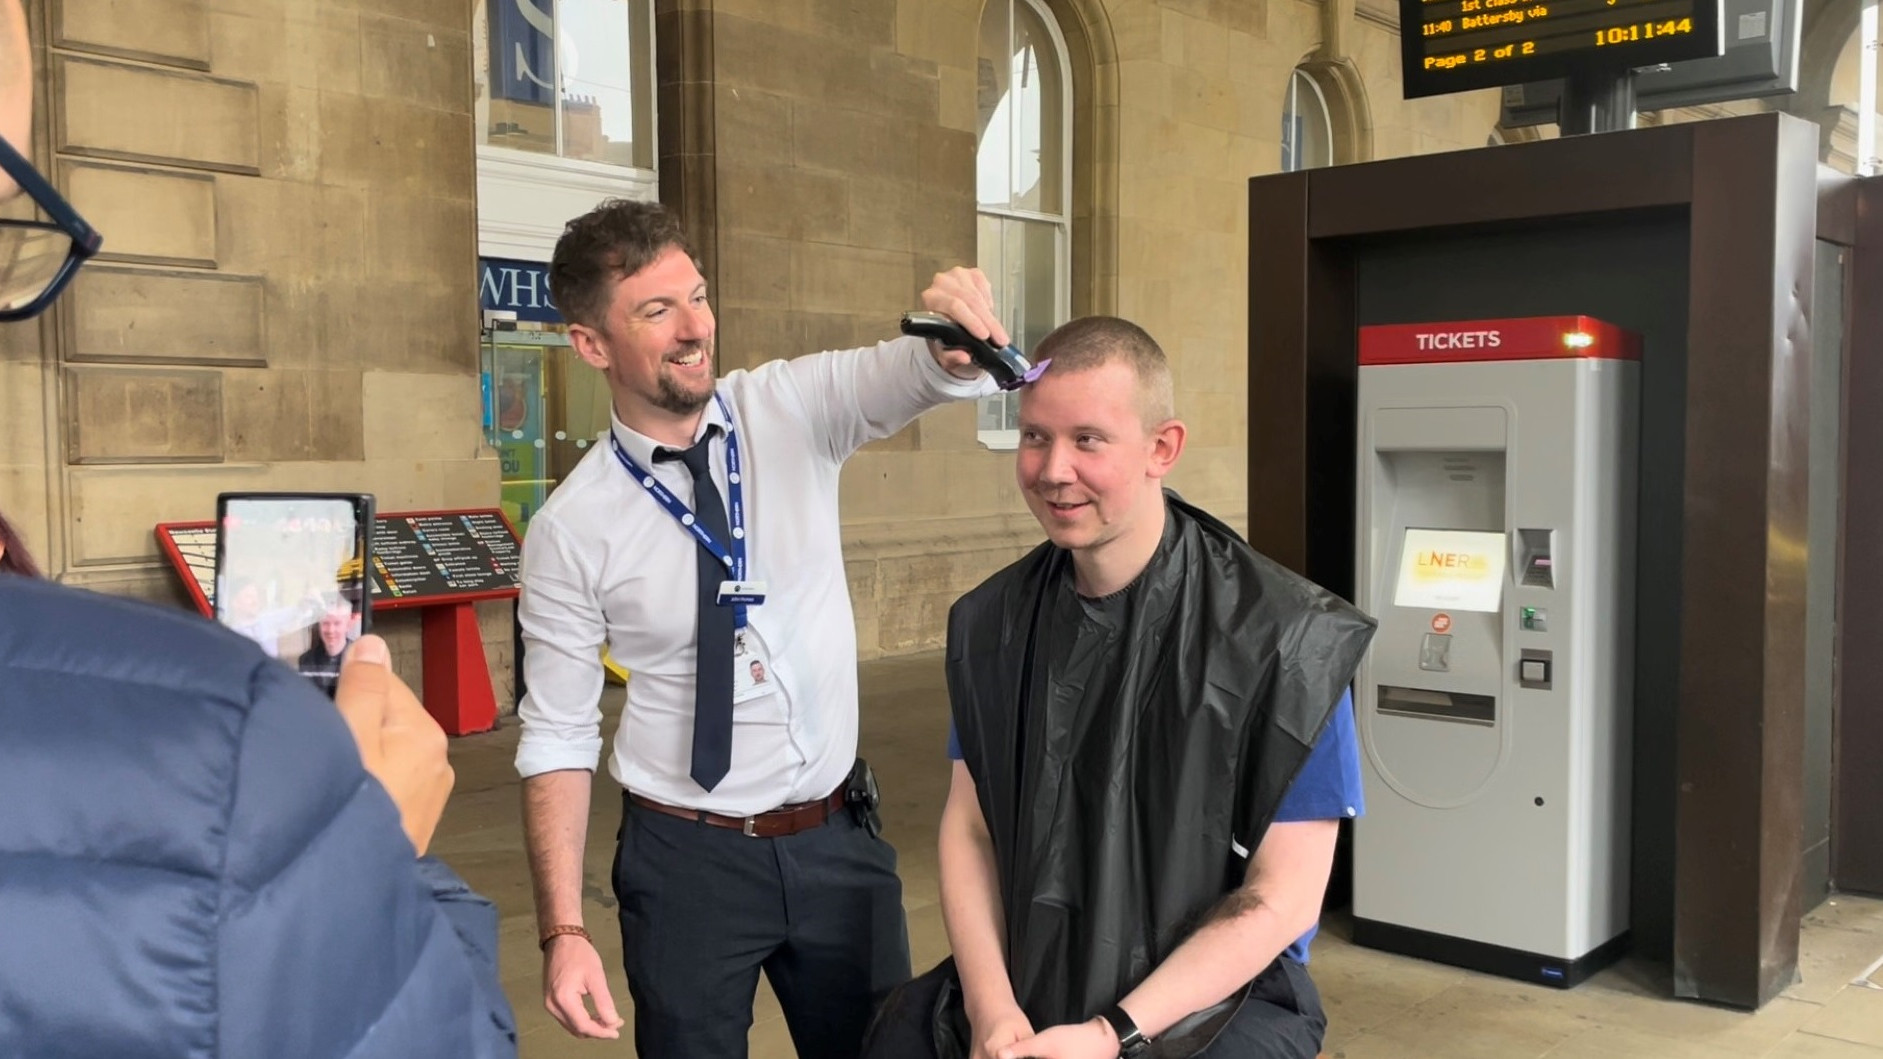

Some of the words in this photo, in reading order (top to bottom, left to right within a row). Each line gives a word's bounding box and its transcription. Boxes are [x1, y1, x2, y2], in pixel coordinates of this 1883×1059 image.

[1422, 20, 1452, 36] 11:40
[1461, 10, 1524, 30] Battersby
[1527, 5, 1548, 18] via
[1595, 17, 1693, 46] 10:11:44
[1424, 54, 1467, 70] Page
[1474, 49, 1487, 62] 2
[1494, 45, 1514, 58] of
[1521, 41, 1536, 55] 2
[1415, 330, 1501, 350] TICKETS
[1417, 550, 1471, 568] LNER
